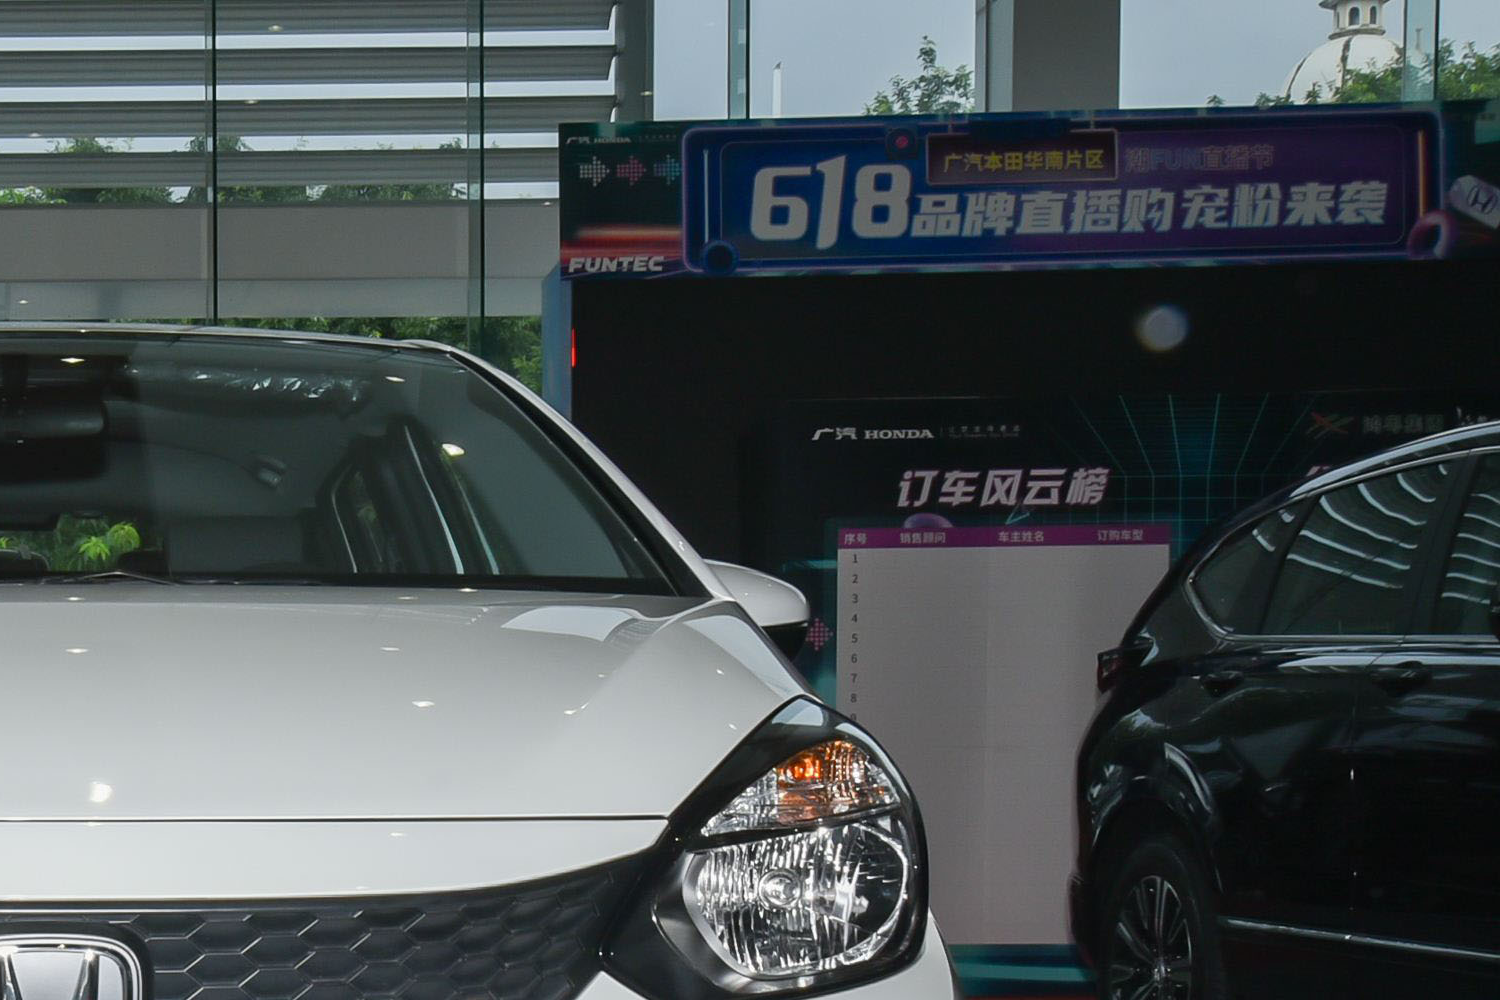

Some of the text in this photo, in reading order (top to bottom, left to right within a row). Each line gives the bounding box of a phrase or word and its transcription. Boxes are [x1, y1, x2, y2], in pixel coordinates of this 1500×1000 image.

[943, 149, 1105, 173] 广汽本田华南片区
[750, 154, 912, 250] 618
[568, 256, 665, 273] FUNTEC
[864, 428, 935, 440] HONDA
[897, 466, 1110, 508] 订车风云榜
[844, 529, 1144, 545] 序号 销售顾问 车主姓名 订购车型
[852, 554, 859, 564] 1
[852, 574, 859, 584] 2
[852, 594, 859, 604] 3
[851, 613, 859, 623] 4
[851, 633, 859, 644] 5
[851, 653, 858, 664] 6
[851, 673, 858, 683] 7
[850, 693, 857, 703] 8
